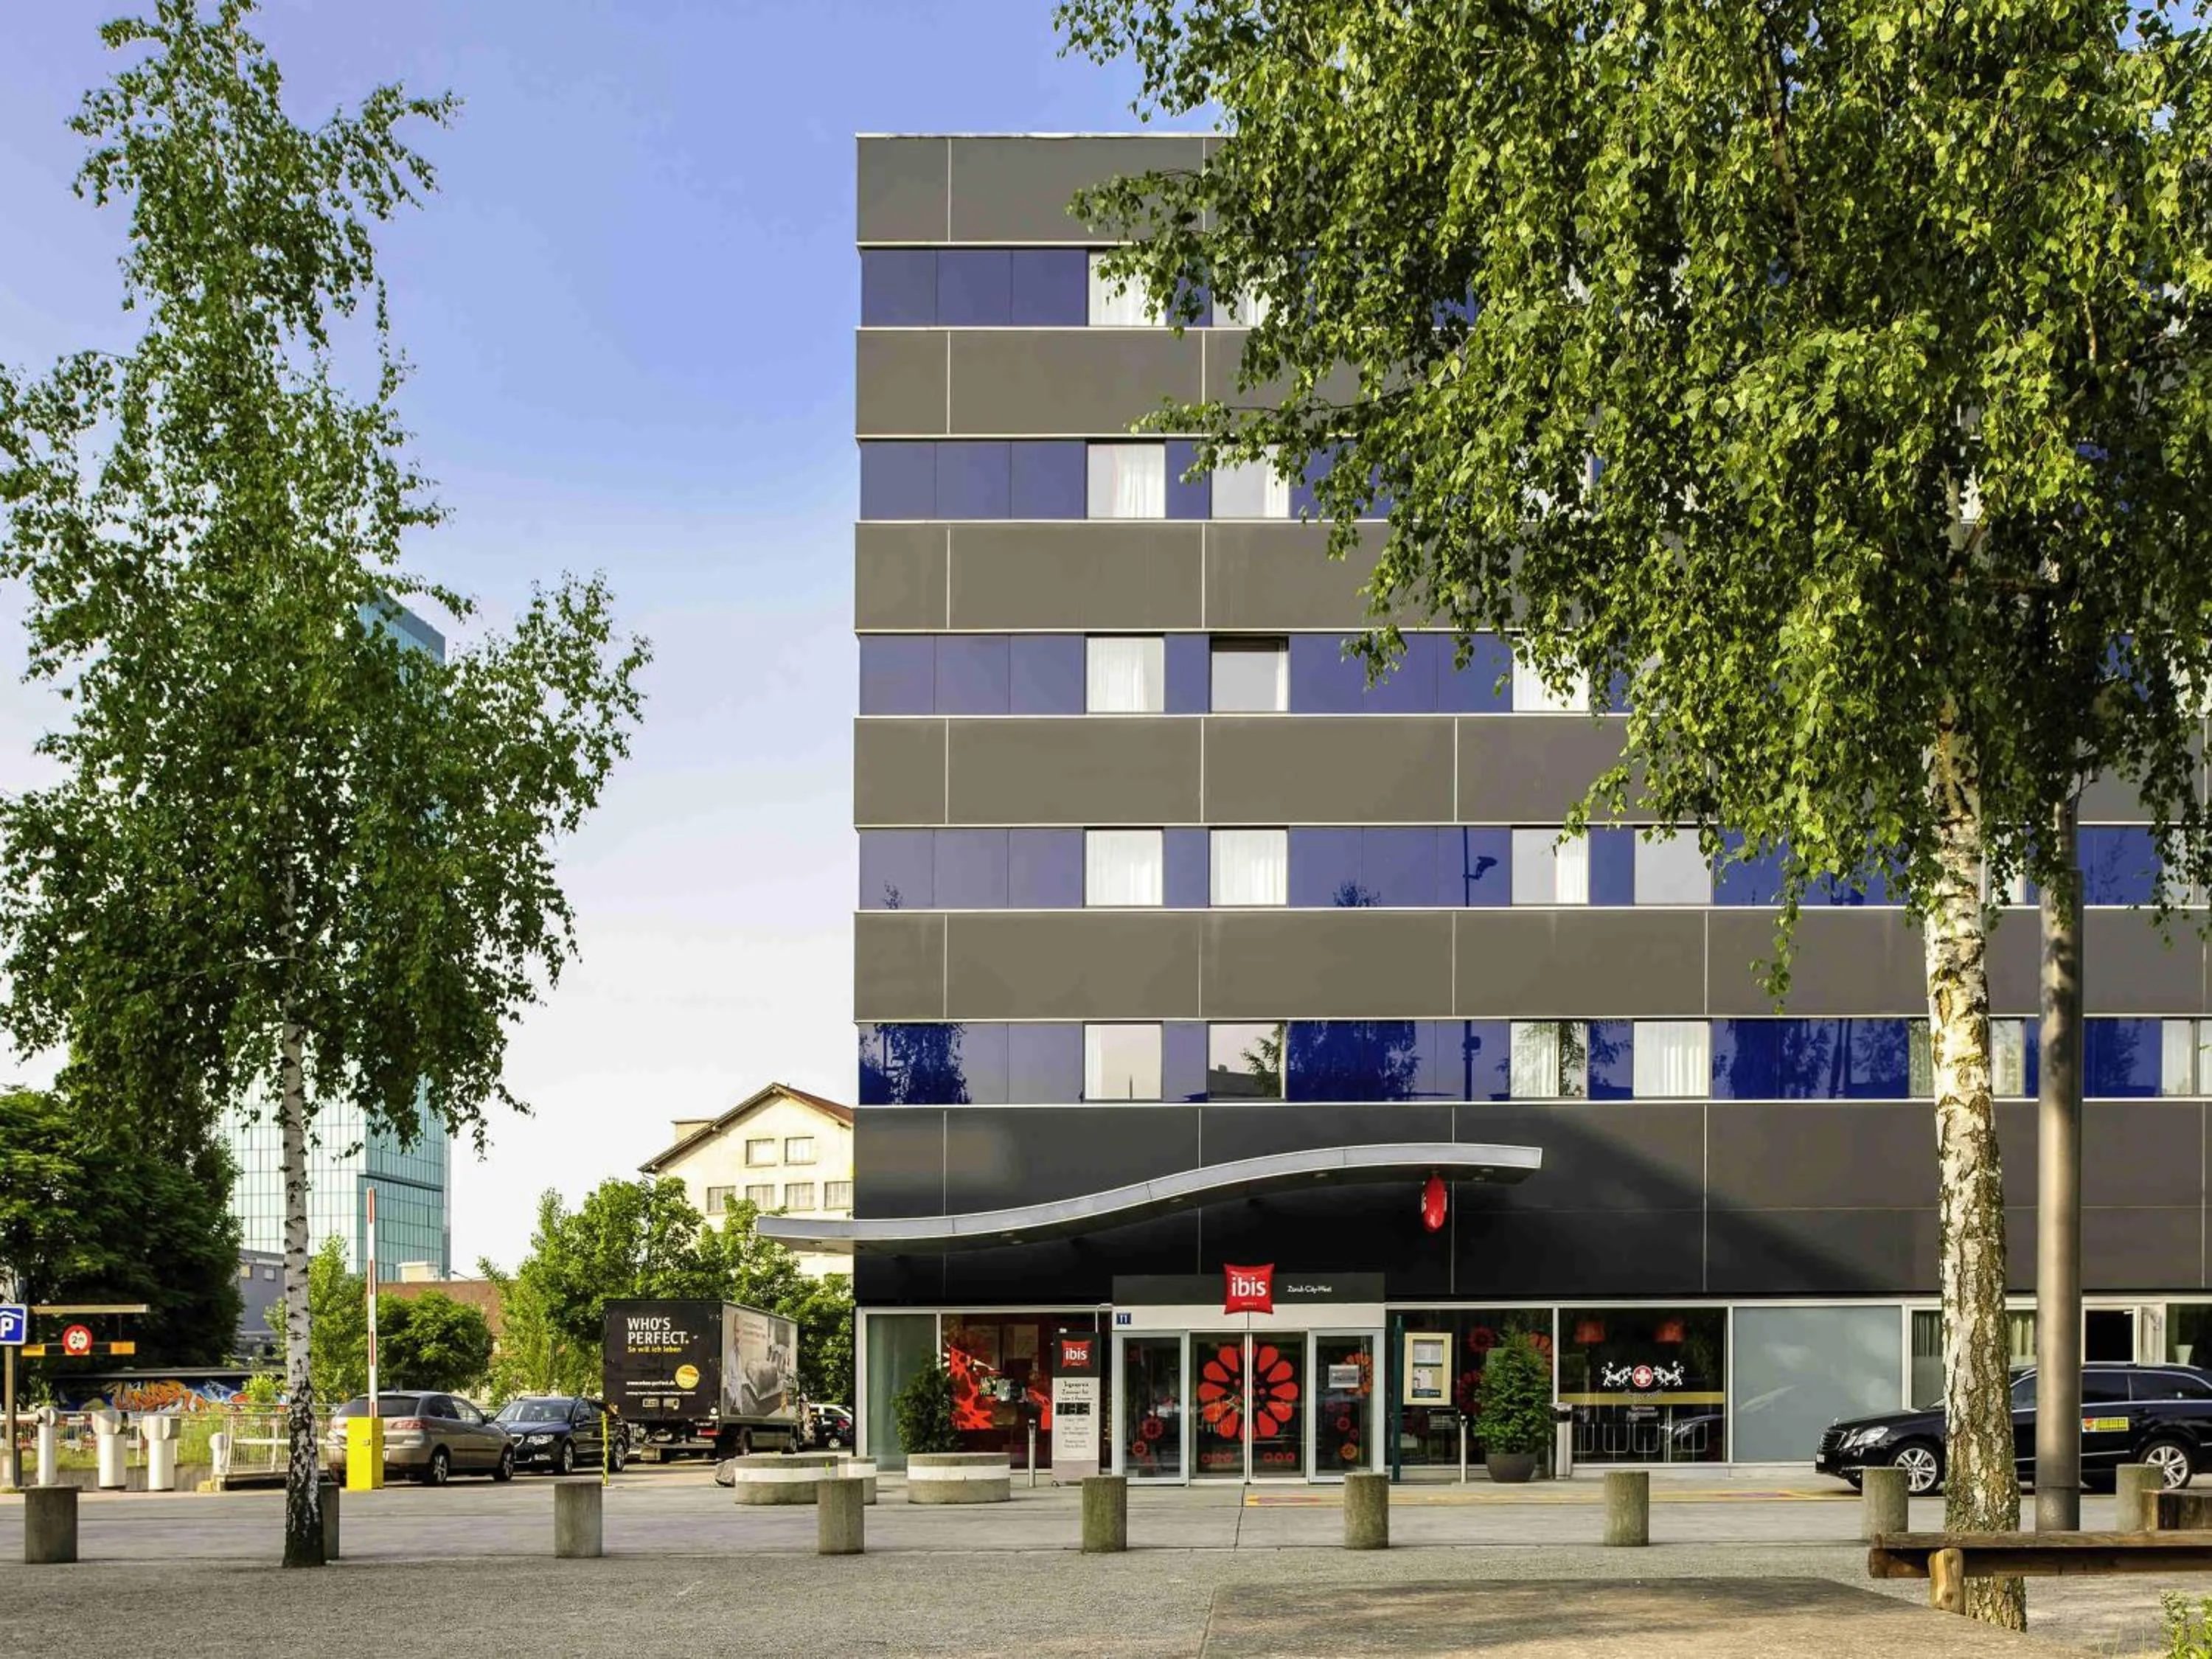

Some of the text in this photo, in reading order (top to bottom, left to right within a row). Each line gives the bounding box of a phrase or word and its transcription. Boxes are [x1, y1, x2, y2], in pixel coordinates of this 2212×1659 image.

[1231, 1276, 1266, 1297] ibis
[627, 1317, 671, 1331] WHO'S
[1120, 1315, 1127, 1324] 11
[1, 1318, 13, 1338] P
[1065, 1347, 1088, 1360] ibis
